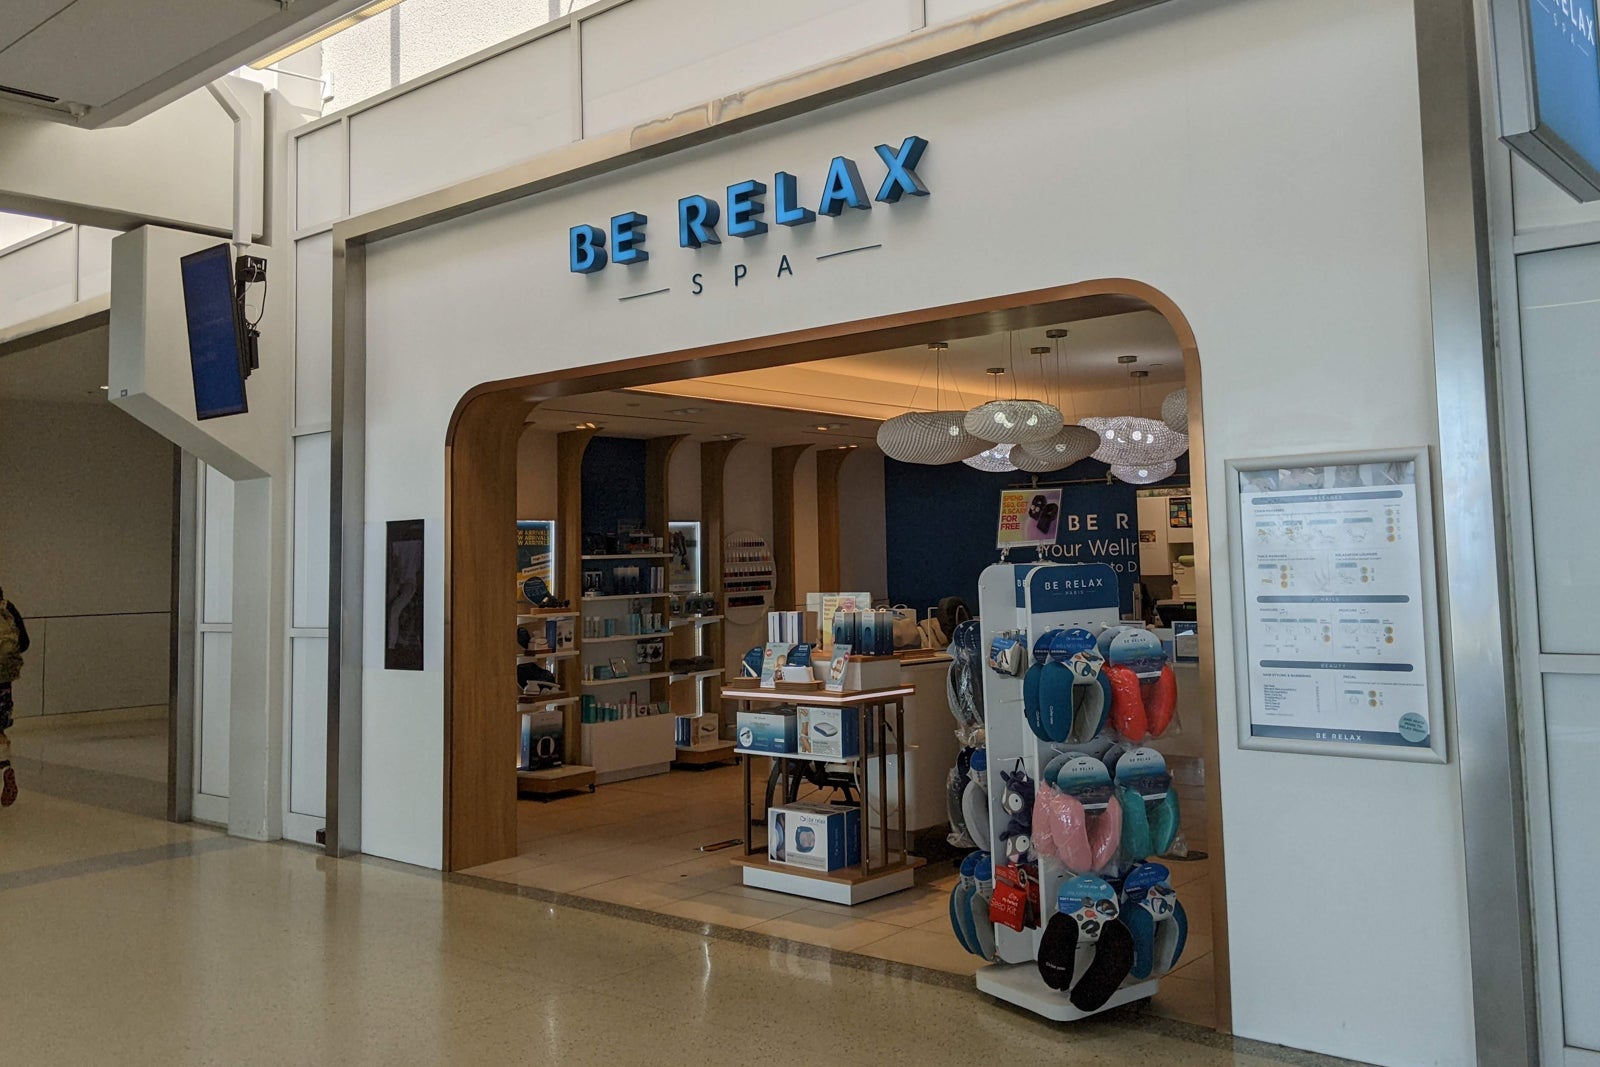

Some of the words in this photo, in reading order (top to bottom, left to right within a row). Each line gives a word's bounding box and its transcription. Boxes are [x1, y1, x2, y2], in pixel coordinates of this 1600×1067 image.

[1556, 0, 1595, 46] ELAX
[570, 211, 649, 274] BE
[678, 135, 930, 249] RELAX
[691, 254, 793, 295] SPA
[1000, 522, 1021, 531] FREE
[1068, 513, 1099, 531] BE
[1043, 543, 1082, 557] Your
[1110, 561, 1124, 573] to
[1044, 581, 1059, 591] BE
[1065, 578, 1103, 589] RELAX
[1331, 733, 1362, 742] RELAX
[1006, 905, 1017, 916] Kit
